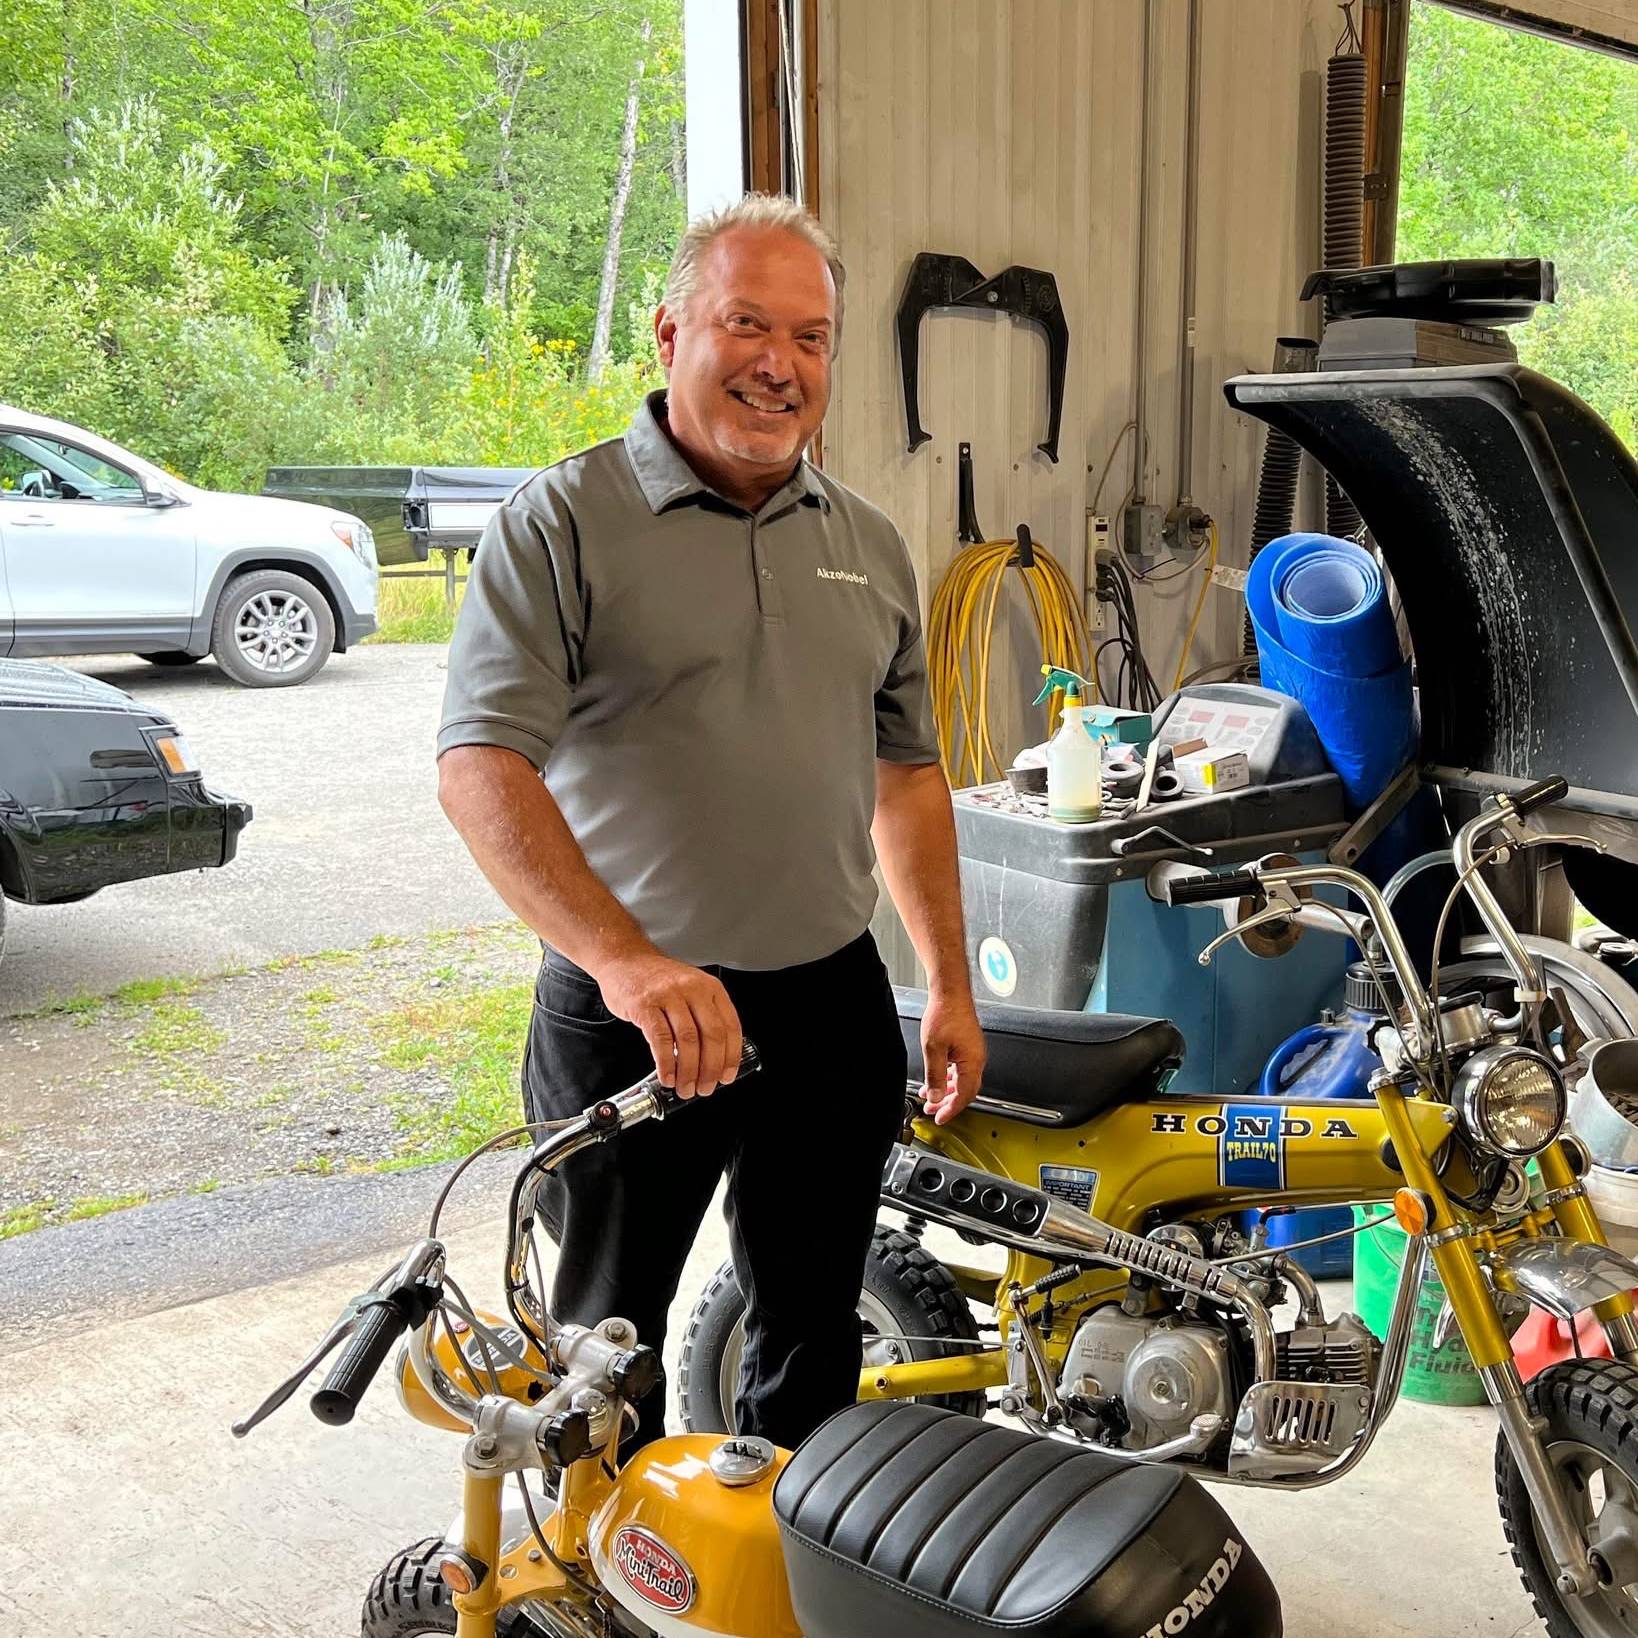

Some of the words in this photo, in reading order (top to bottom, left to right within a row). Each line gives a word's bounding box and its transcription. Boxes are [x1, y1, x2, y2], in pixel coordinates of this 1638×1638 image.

[816, 567, 868, 585] AkzoNobel
[1151, 1113, 1359, 1139] HONDA
[636, 1540, 677, 1576] HONDA
